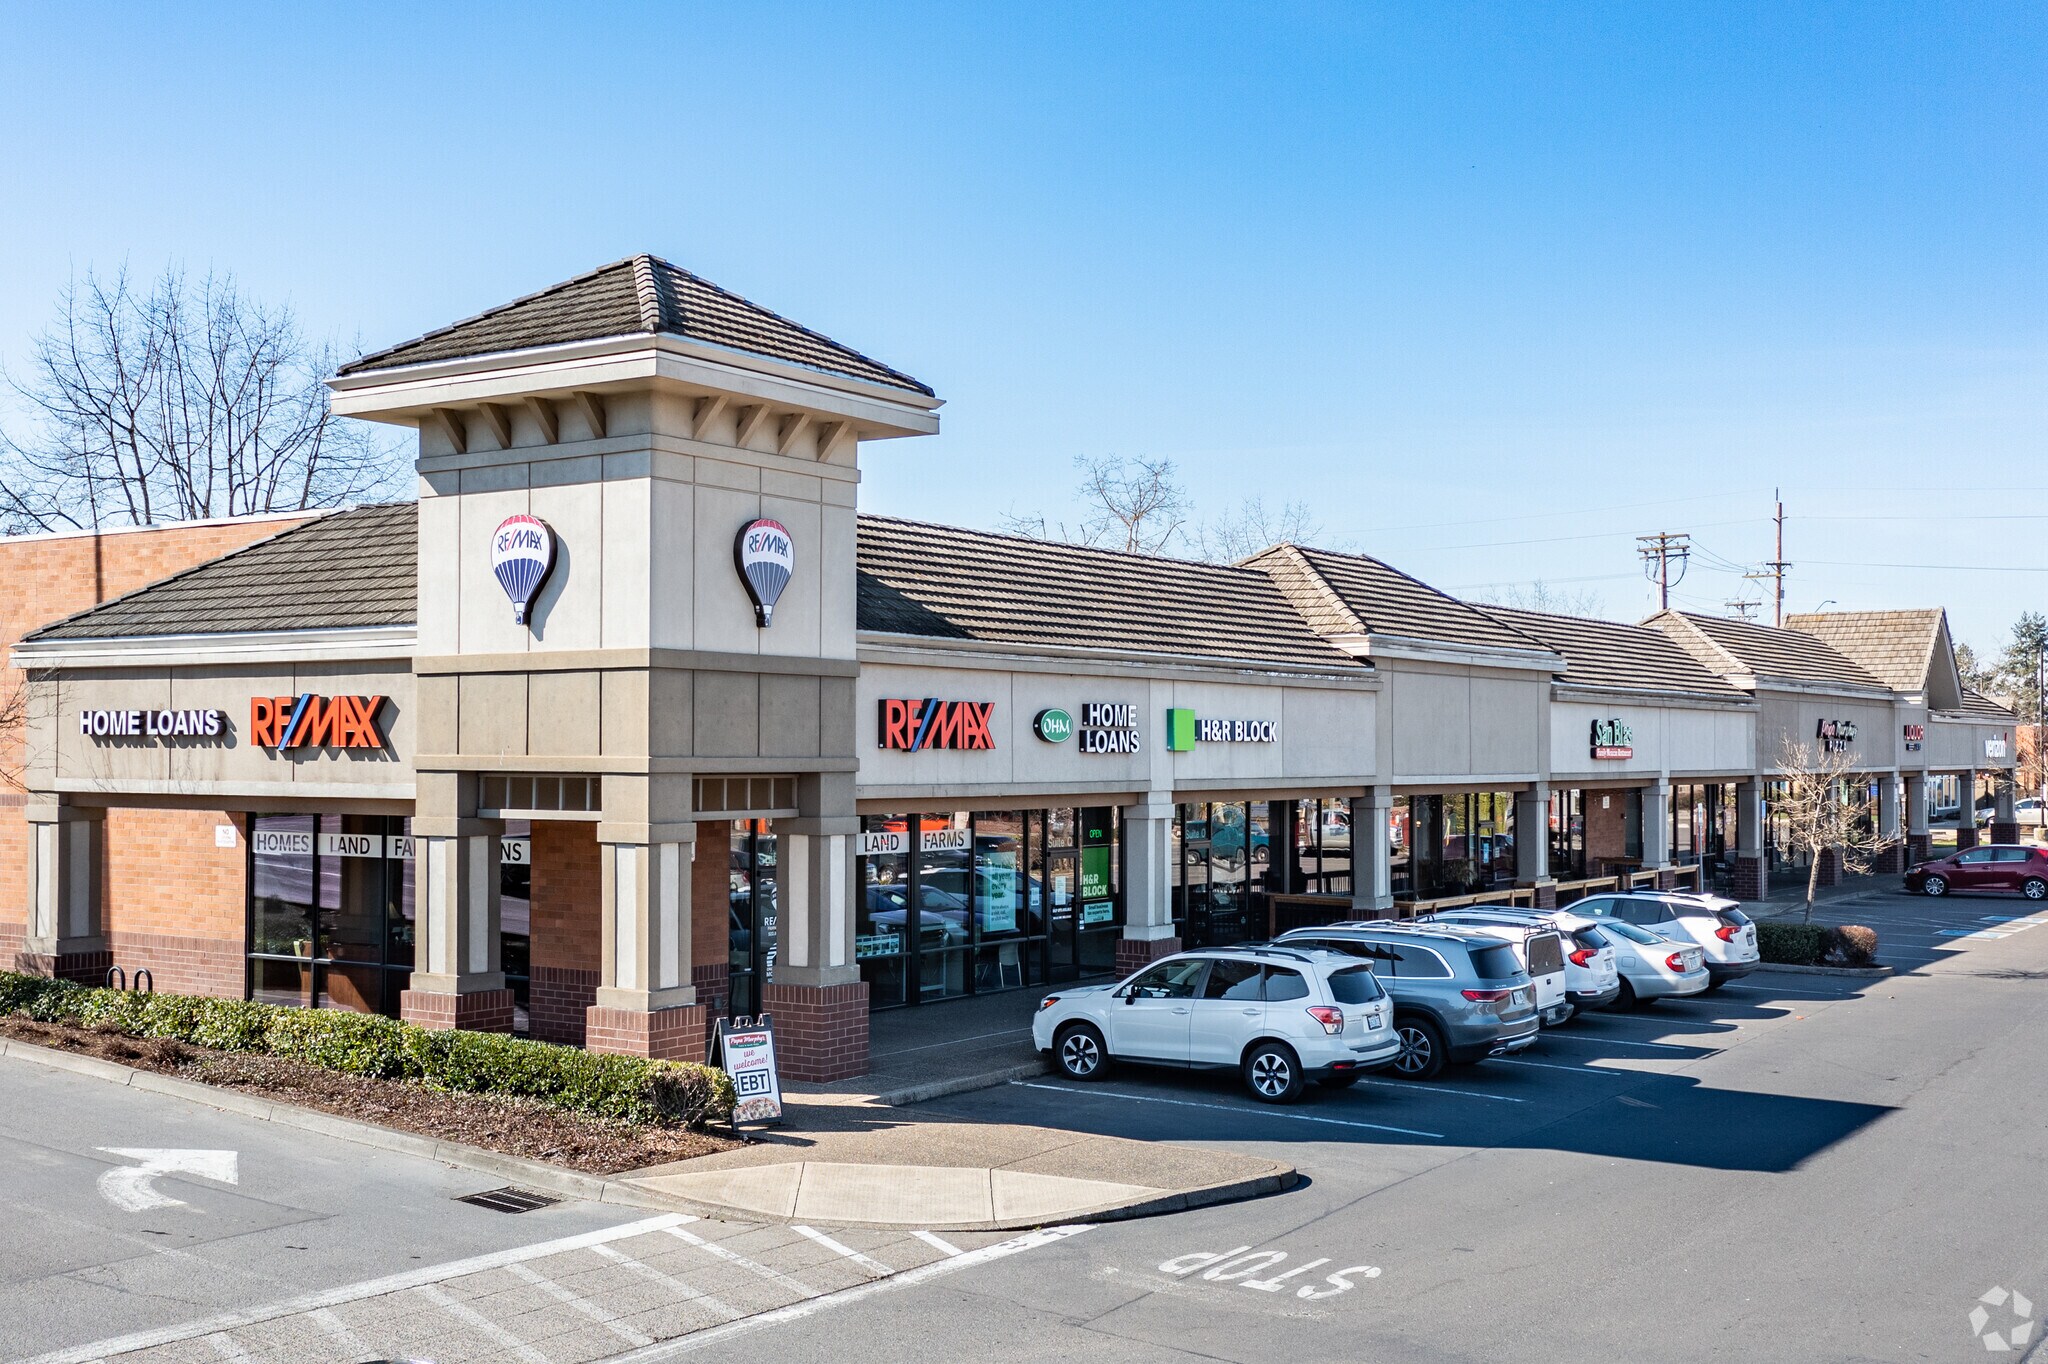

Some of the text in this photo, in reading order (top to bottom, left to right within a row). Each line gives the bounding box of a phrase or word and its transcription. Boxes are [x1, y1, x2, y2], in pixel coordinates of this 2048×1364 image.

[498, 529, 543, 553] RE/MAX
[749, 532, 788, 558] RE/MAX
[79, 709, 220, 736] HOME LOANS
[251, 693, 382, 750] RE/MAX
[1089, 703, 1137, 727] HOME
[886, 697, 996, 753] RE/MAX
[1043, 718, 1070, 733] OHM
[1201, 719, 1278, 742] H&R BLOCK
[1596, 719, 1632, 746] San Blas
[1086, 730, 1140, 754] LOANS
[257, 833, 309, 852] HOMES
[865, 834, 899, 852] LAND
[924, 831, 965, 849] FARMS
[1048, 838, 1065, 848] Suite
[1089, 829, 1103, 839] OPEN
[330, 836, 370, 854] LAND
[394, 838, 416, 857] FA
[501, 843, 522, 861] NS
[1083, 874, 1099, 885] H&R
[1083, 885, 1107, 897] BLOCK
[764, 916, 777, 926] RE/
[734, 1053, 768, 1070] welcome!
[744, 1049, 755, 1058] we
[740, 1073, 766, 1092] EBT
[1158, 1245, 1382, 1300] STOP
